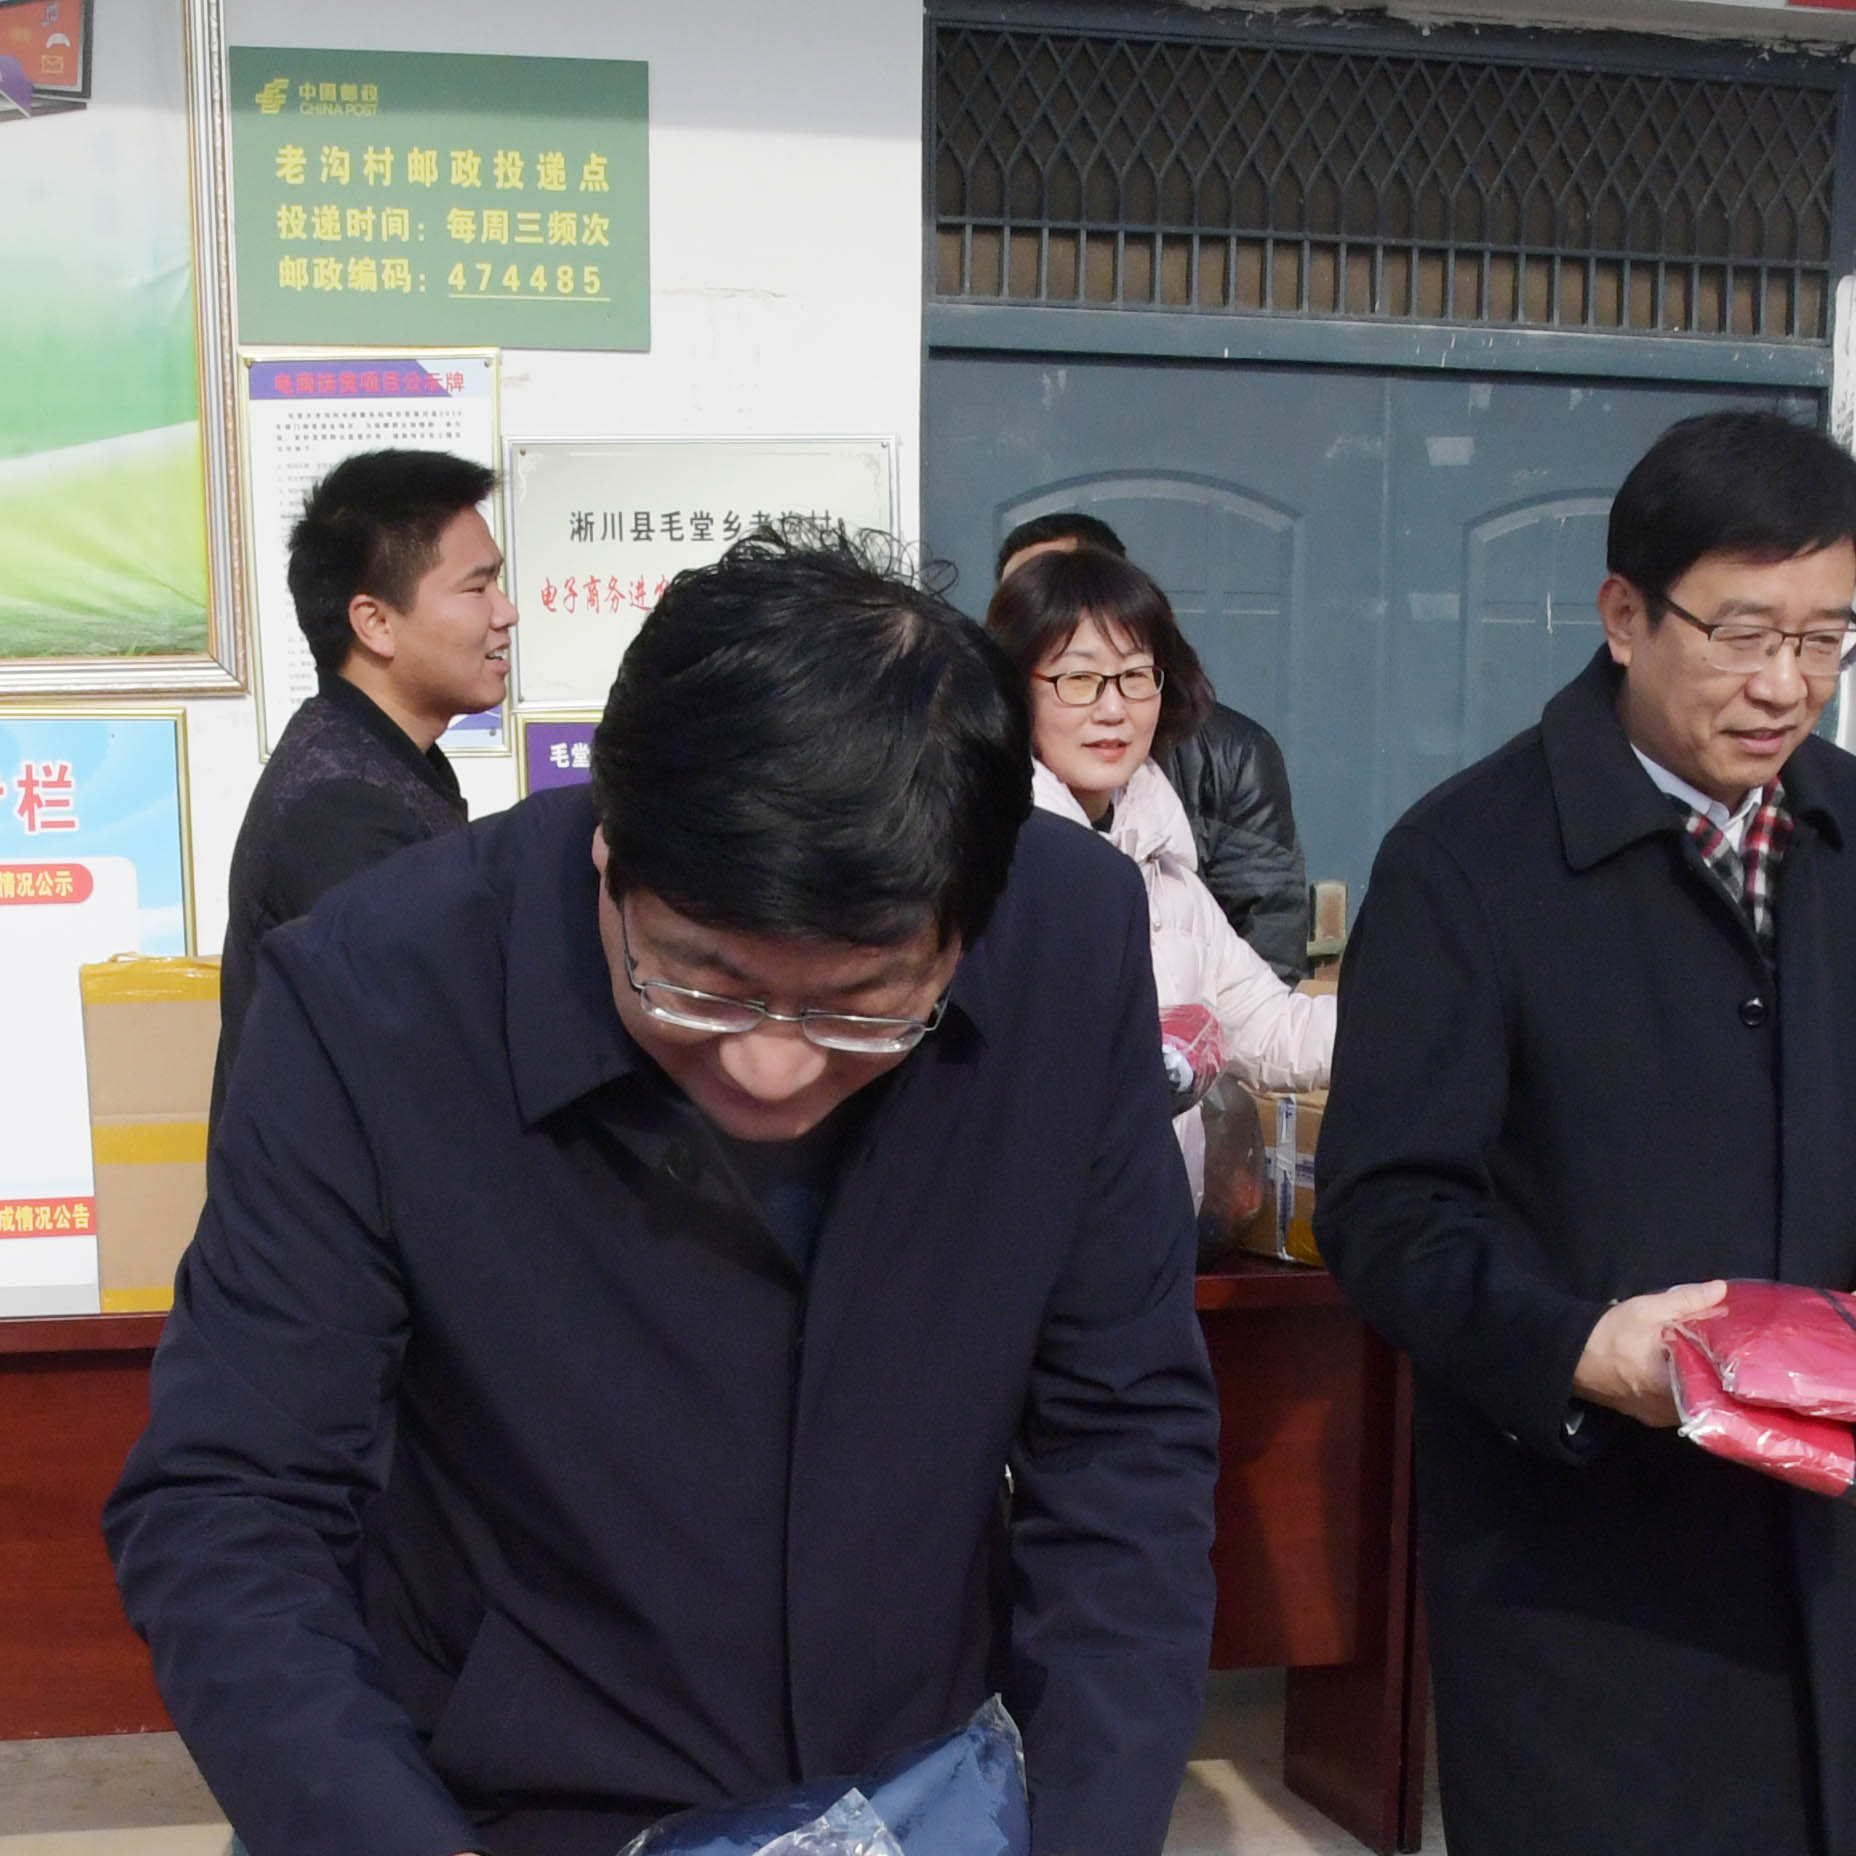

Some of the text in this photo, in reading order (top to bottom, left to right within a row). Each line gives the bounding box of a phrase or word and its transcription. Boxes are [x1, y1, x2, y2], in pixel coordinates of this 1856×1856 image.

[298, 82, 379, 102] 中国邮政
[298, 101, 379, 117] CHINA POST
[275, 144, 610, 192] 老沟村邮政投递点
[276, 205, 611, 247] 投递时间： 每周三频次
[279, 256, 602, 294] 邮政编码： 474485
